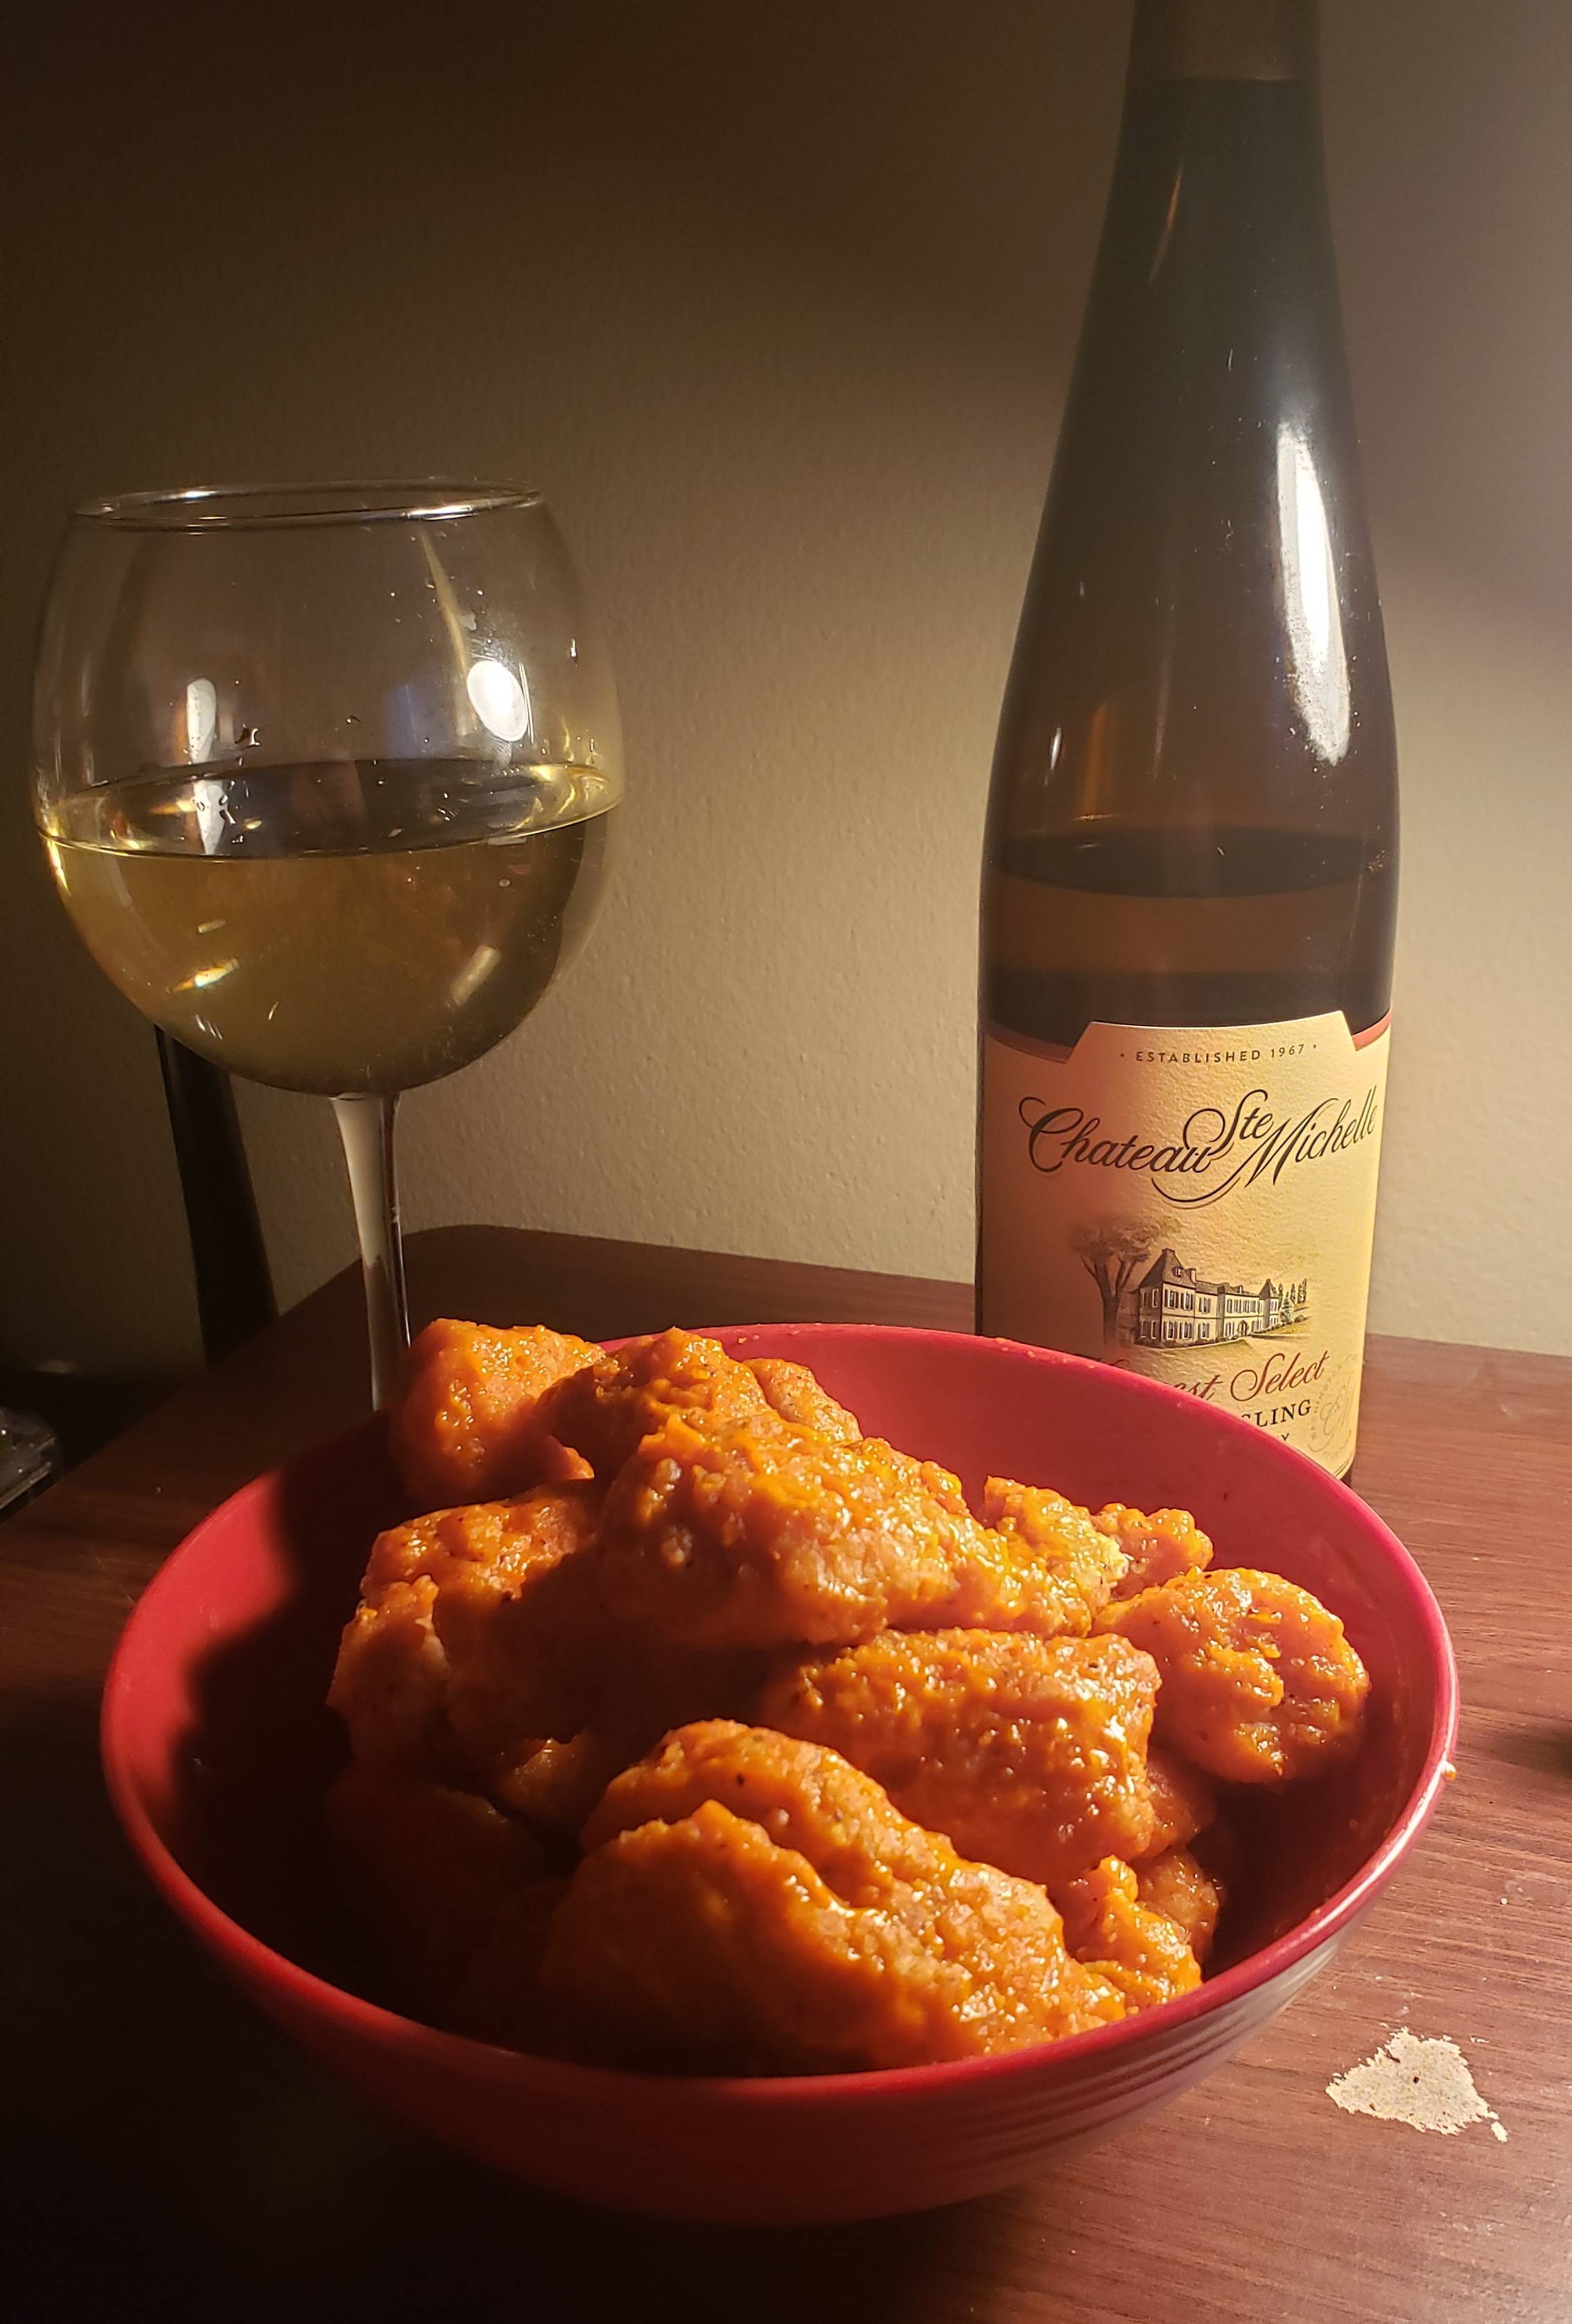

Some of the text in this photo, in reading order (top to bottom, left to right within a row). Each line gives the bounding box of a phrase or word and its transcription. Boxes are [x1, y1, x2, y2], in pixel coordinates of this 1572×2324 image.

[1135, 1044, 1304, 1063] ESTABLISHED 1967
[1019, 1085, 1378, 1188] Chateau Ste Michelle
[1230, 1349, 1329, 1401] Select
